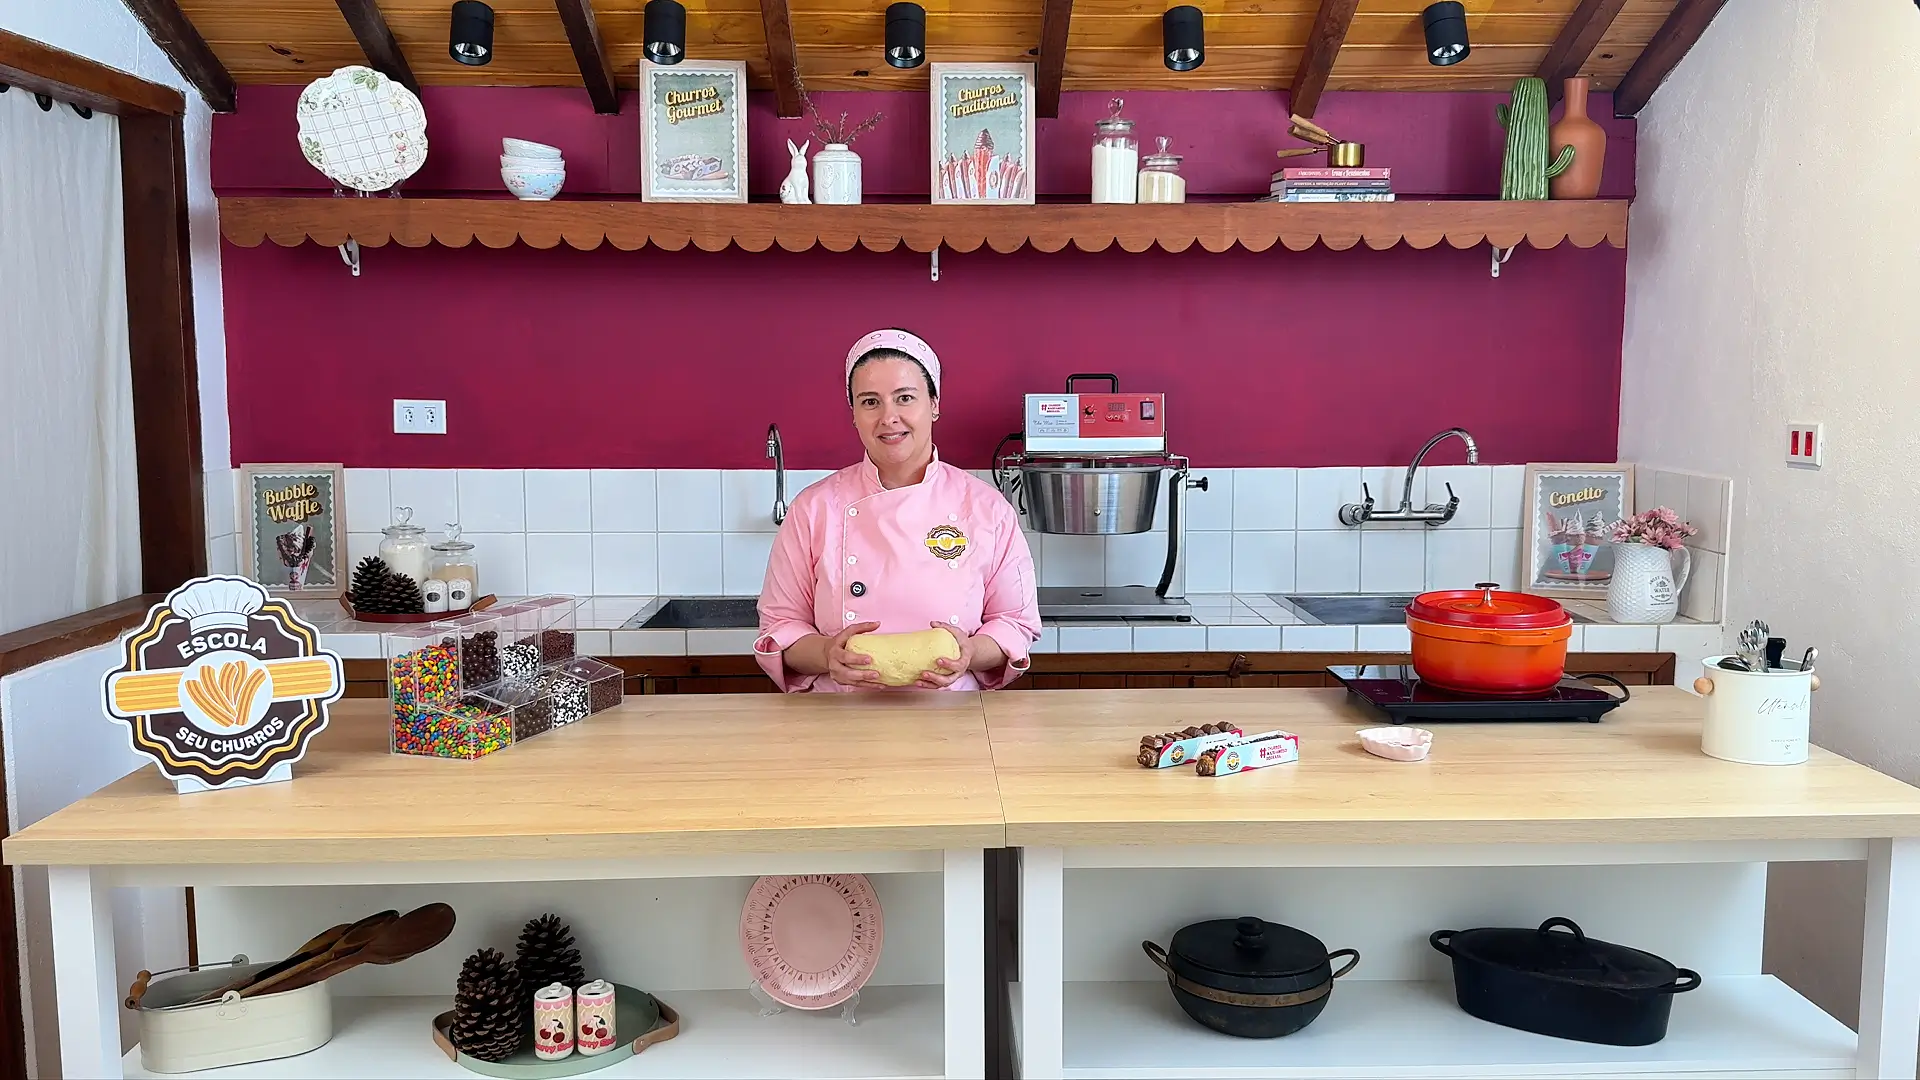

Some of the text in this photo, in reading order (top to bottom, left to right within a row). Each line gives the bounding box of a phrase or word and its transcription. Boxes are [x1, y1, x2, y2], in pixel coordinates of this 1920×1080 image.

[665, 86, 718, 106] Churros
[950, 93, 1017, 117] Tradicional
[958, 84, 1004, 102] Churros
[667, 99, 723, 125] Gourmet
[263, 482, 317, 505] Bubble
[1549, 487, 1606, 507] Conetto
[267, 499, 322, 523] Waffle
[176, 632, 267, 659] ESCOLA
[175, 716, 285, 753] SEU CHURROS
